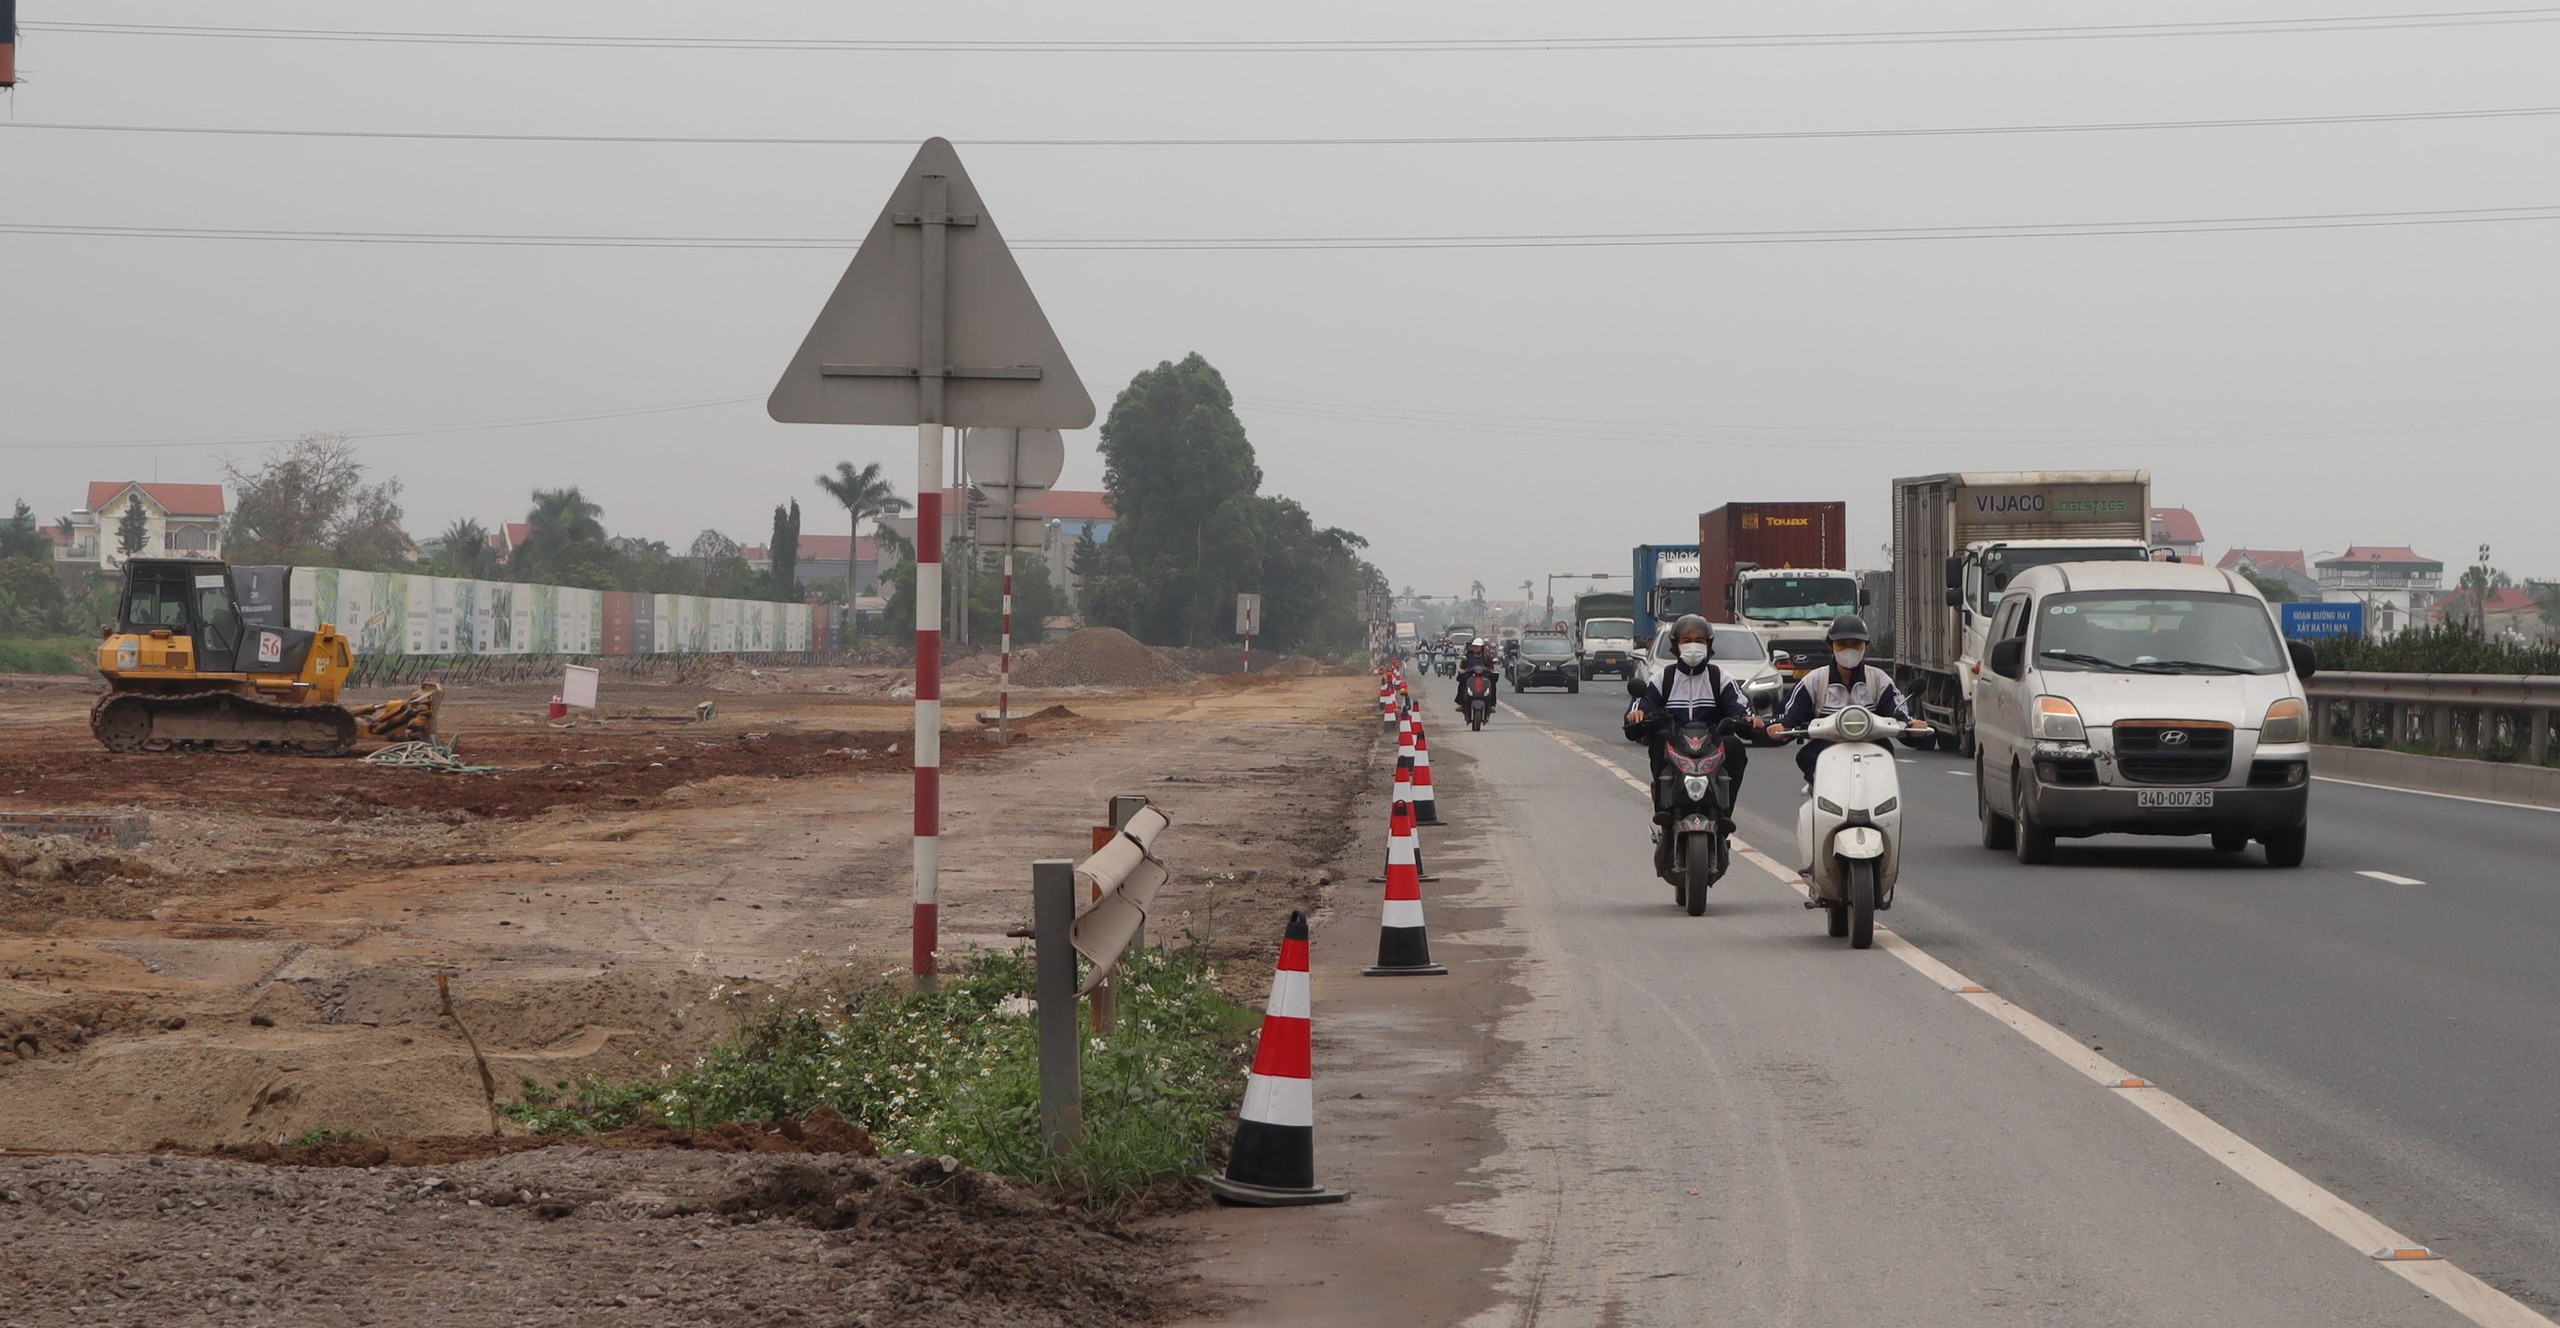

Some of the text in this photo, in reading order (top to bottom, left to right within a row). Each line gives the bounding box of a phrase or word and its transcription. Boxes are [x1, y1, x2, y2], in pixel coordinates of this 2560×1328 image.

[1976, 495, 2125, 512] VIJACO LOGISTICS
[1658, 551, 1700, 561] SINOK
[2337, 611, 2351, 620] HAY
[2311, 622, 2321, 632] RA
[261, 637, 280, 657] 56
[2140, 791, 2211, 806] 34D-007.35
